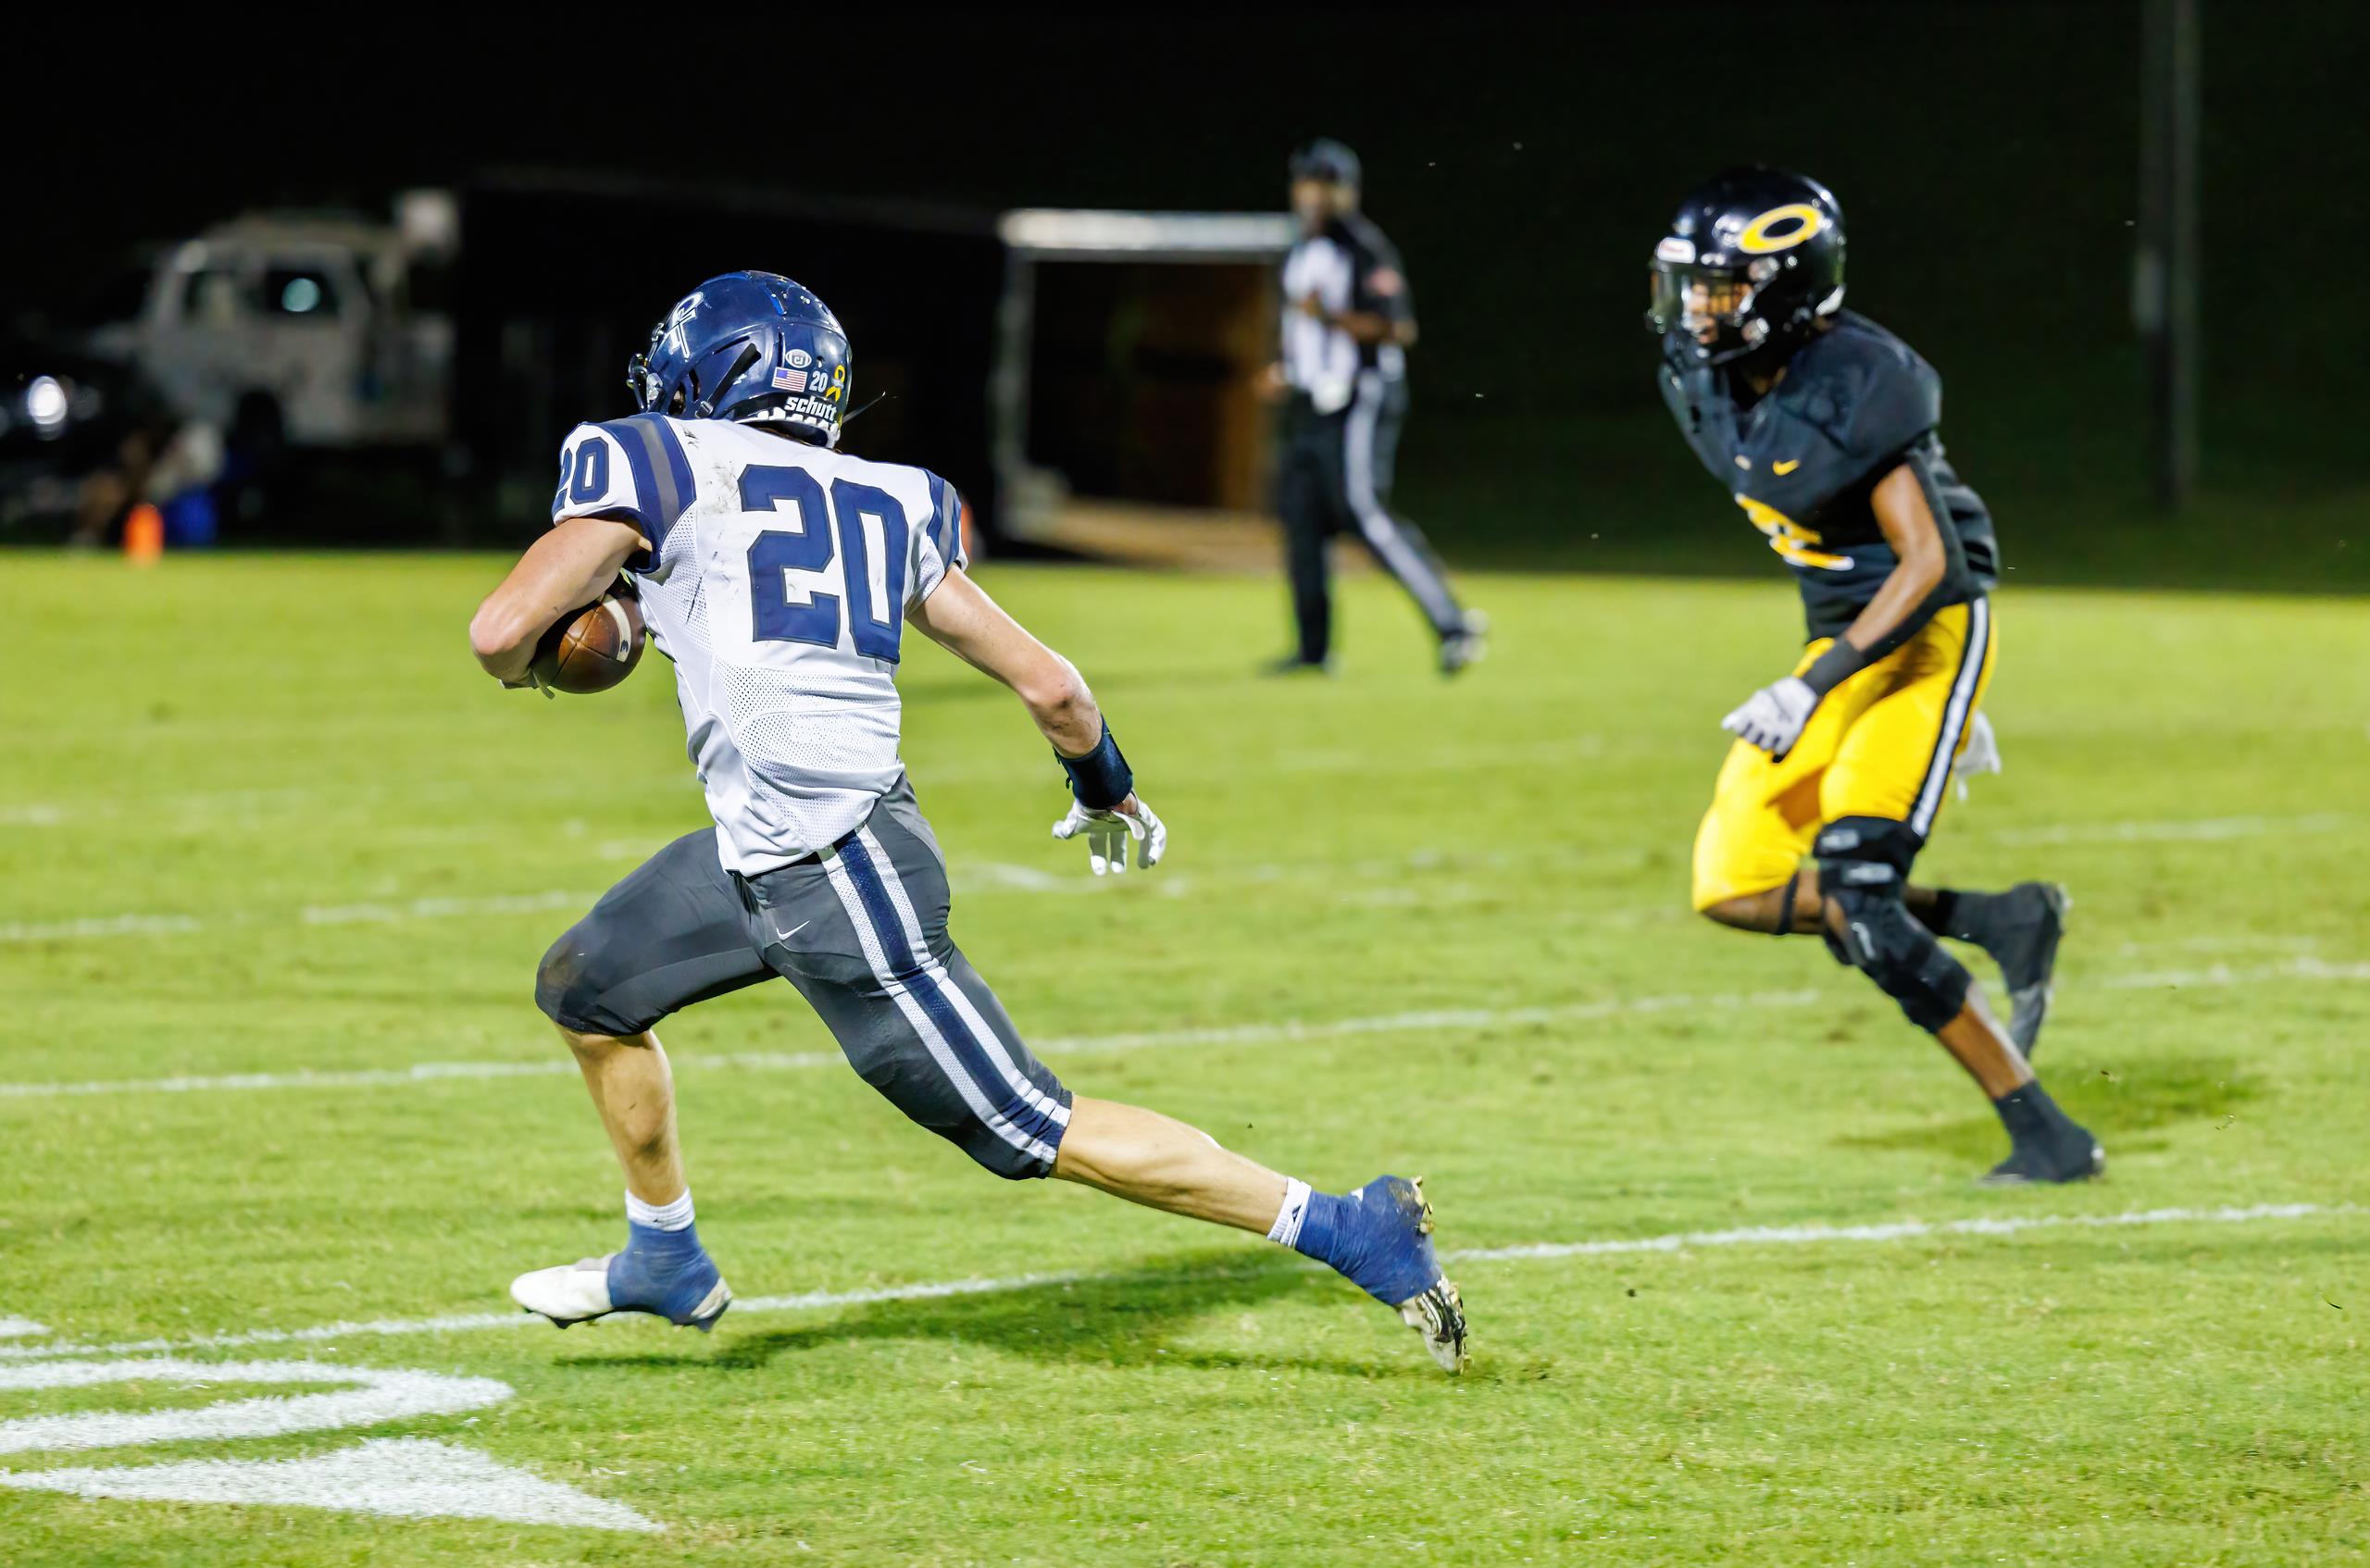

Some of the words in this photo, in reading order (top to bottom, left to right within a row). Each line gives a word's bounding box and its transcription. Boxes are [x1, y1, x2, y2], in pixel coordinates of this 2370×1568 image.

[809, 370, 829, 392] 20
[784, 395, 837, 421] schutt
[738, 464, 909, 664] 20
